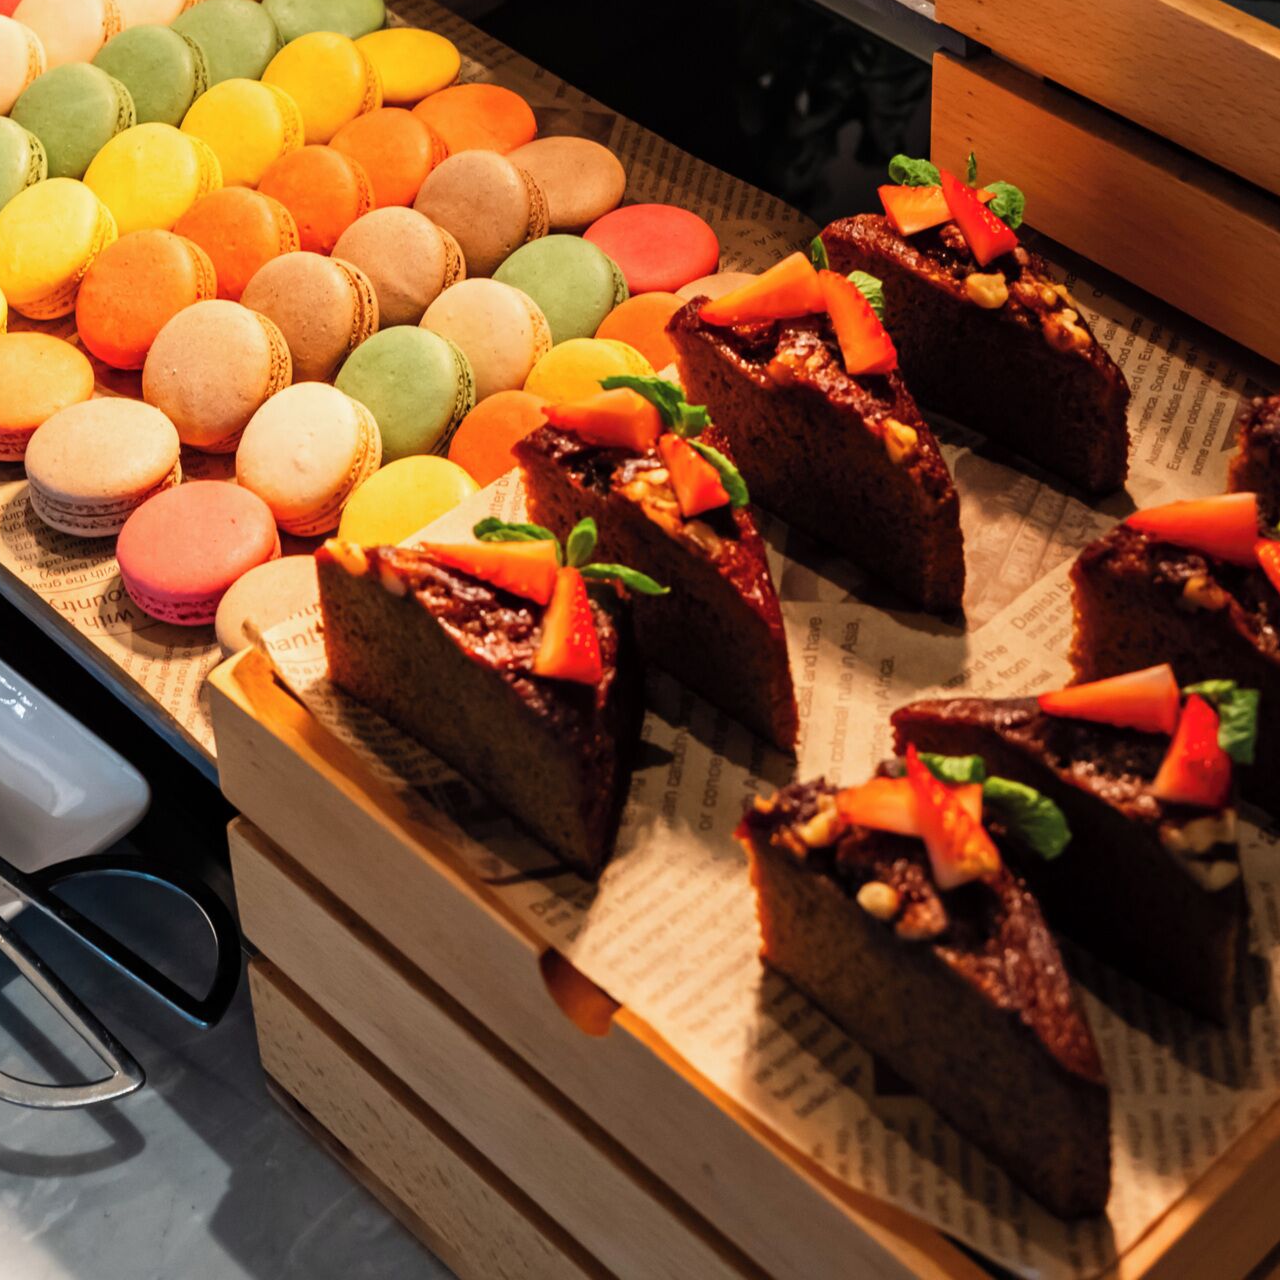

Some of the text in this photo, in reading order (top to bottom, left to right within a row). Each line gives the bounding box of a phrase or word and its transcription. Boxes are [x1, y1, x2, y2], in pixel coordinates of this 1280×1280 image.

[1133, 361, 1147, 375] in
[1134, 390, 1161, 436] America,
[1149, 360, 1169, 394] South
[1216, 388, 1230, 400] in
[1144, 421, 1171, 467] Australia,
[1160, 391, 1182, 425] Middle
[1172, 367, 1191, 393] East
[1166, 422, 1195, 472] European
[1182, 384, 1208, 426] colonial
[1199, 399, 1226, 448] countries
[1190, 446, 1209, 477] some
[18, 562, 33, 573] of
[38, 560, 89, 582] barley)
[63, 573, 87, 587] the
[89, 564, 119, 580] with
[82, 606, 134, 632] with
[1008, 585, 1061, 633] Danish
[803, 614, 824, 652] have
[839, 615, 863, 654] Asia,
[155, 644, 174, 682] enerally
[800, 652, 820, 683] and
[981, 639, 1008, 666] the
[996, 651, 1031, 685] from
[173, 685, 182, 698] as
[834, 670, 854, 702] rule
[824, 704, 852, 763] colonial
[696, 811, 714, 831] or
